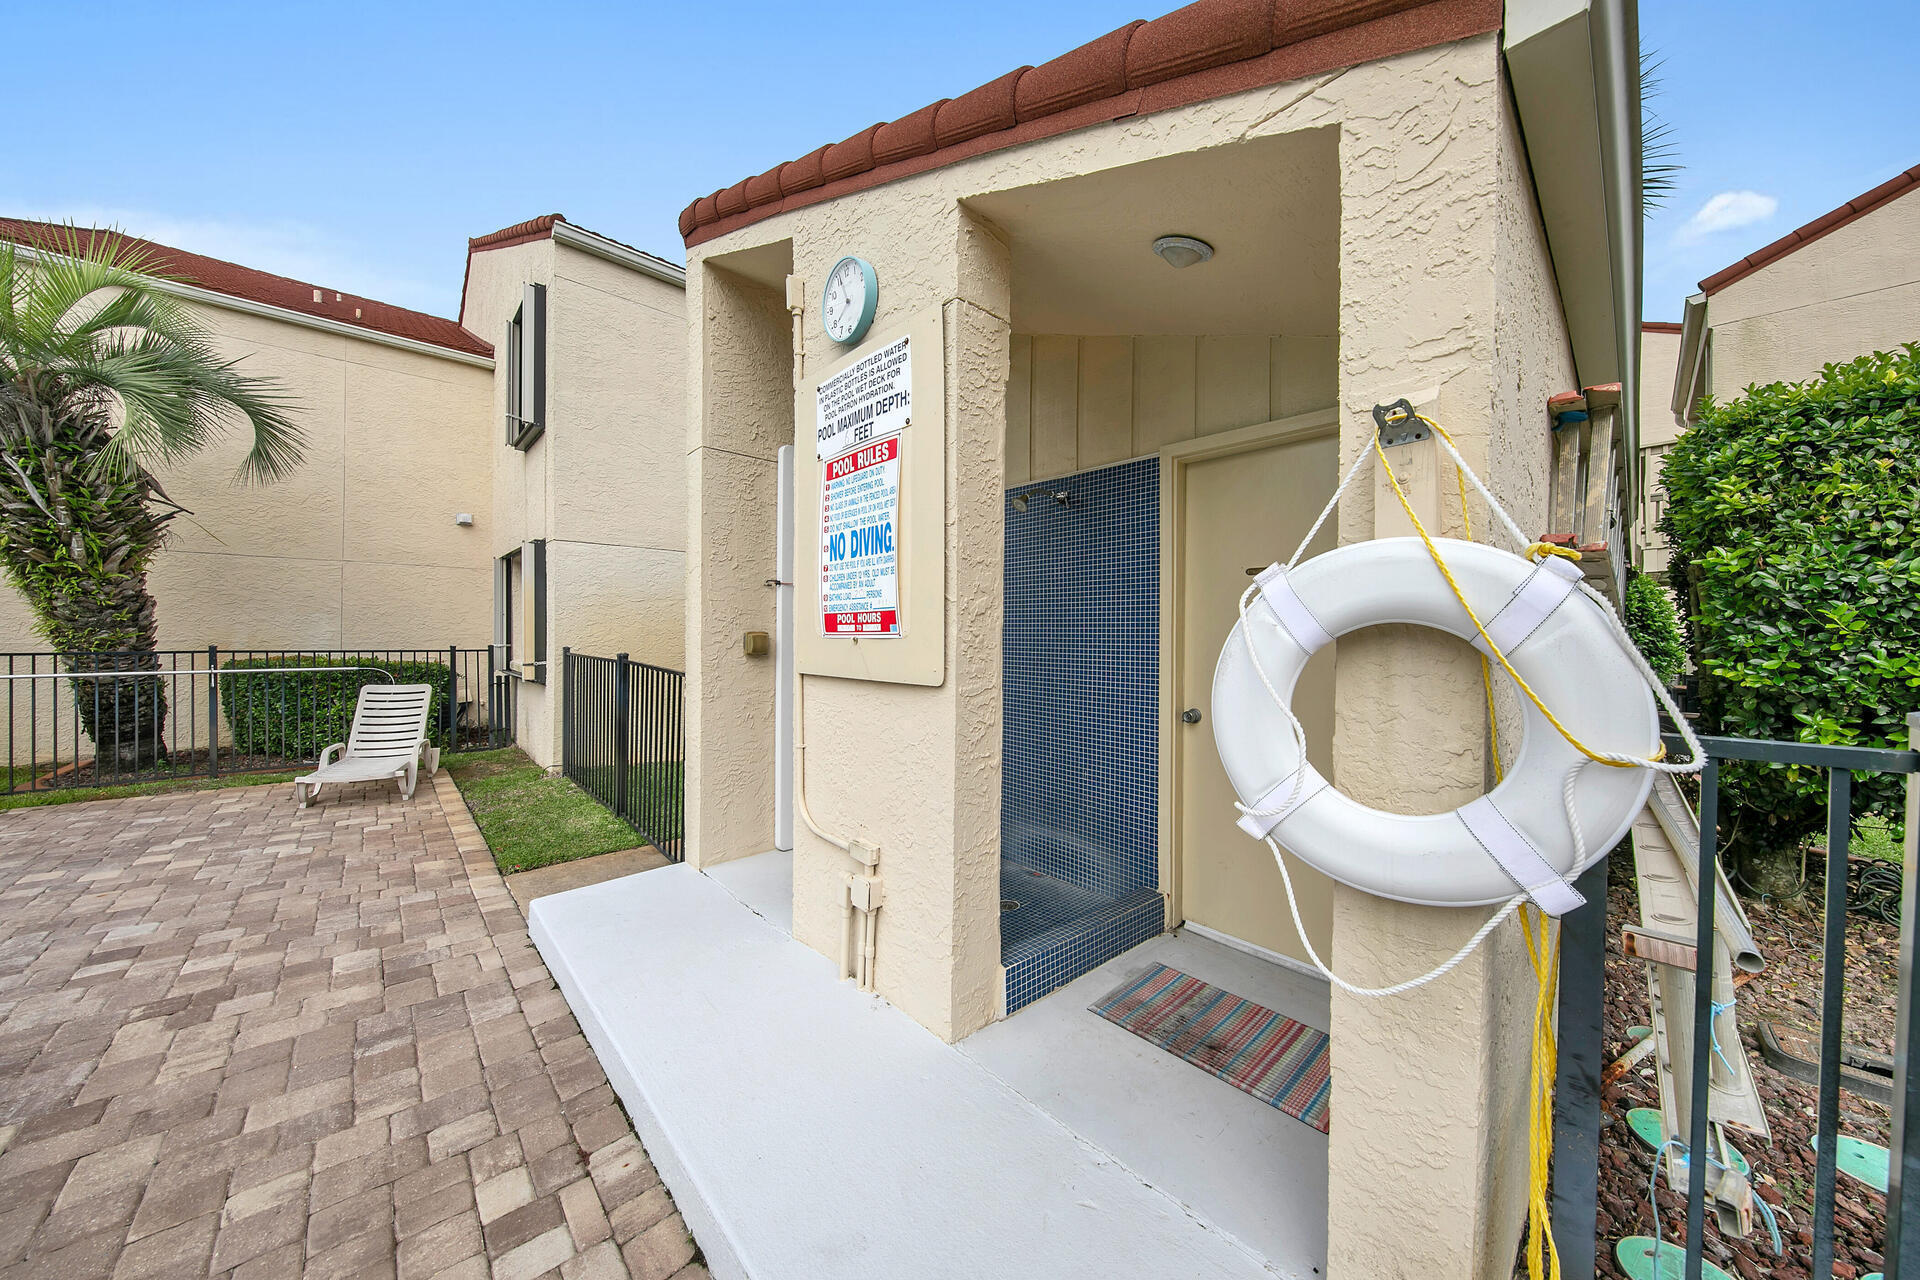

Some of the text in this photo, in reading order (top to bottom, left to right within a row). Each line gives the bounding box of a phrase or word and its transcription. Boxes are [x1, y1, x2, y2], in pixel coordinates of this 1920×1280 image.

[845, 266, 849, 278] 12
[860, 272, 863, 281] 2
[832, 291, 837, 300] 10
[830, 307, 833, 315] 9
[833, 320, 837, 328] 8
[840, 326, 843, 334] 7
[848, 325, 852, 334] 6
[819, 341, 906, 394] COMMERCIALLY BOTTLED WATER
[819, 352, 907, 405] IN PLASTIC BOTTLES IS ALLOWED
[823, 367, 900, 412] ON THE POOL WET DECK FOR
[825, 382, 895, 421] POOL PATRON HYDRATION.
[818, 390, 910, 442] POOL MAXIMUM DEPTH:
[854, 422, 874, 442] FEET
[832, 443, 889, 477] POOL RULES
[851, 470, 868, 483] LIFEGUARD
[831, 490, 843, 500] SHOWER
[845, 486, 856, 497] BEFORE
[858, 480, 873, 493] ENTERING
[848, 496, 859, 506] ANIMALS
[870, 490, 880, 500] FENCED
[830, 524, 835, 532] DO
[843, 519, 858, 530] SWALLOW
[867, 515, 877, 524] POOL
[830, 532, 846, 562] NO
[851, 522, 894, 558] DIVING.
[829, 574, 845, 582] CHILDREN
[846, 572, 857, 580] UNDER
[880, 567, 890, 576] MUST
[891, 566, 894, 574] BE
[830, 582, 852, 591] ACCOMPANIED
[829, 593, 842, 601] BATHING
[866, 589, 882, 599] PERSONS
[849, 602, 868, 611] ASSISTANCE
[837, 612, 881, 624] POOL HOURS
